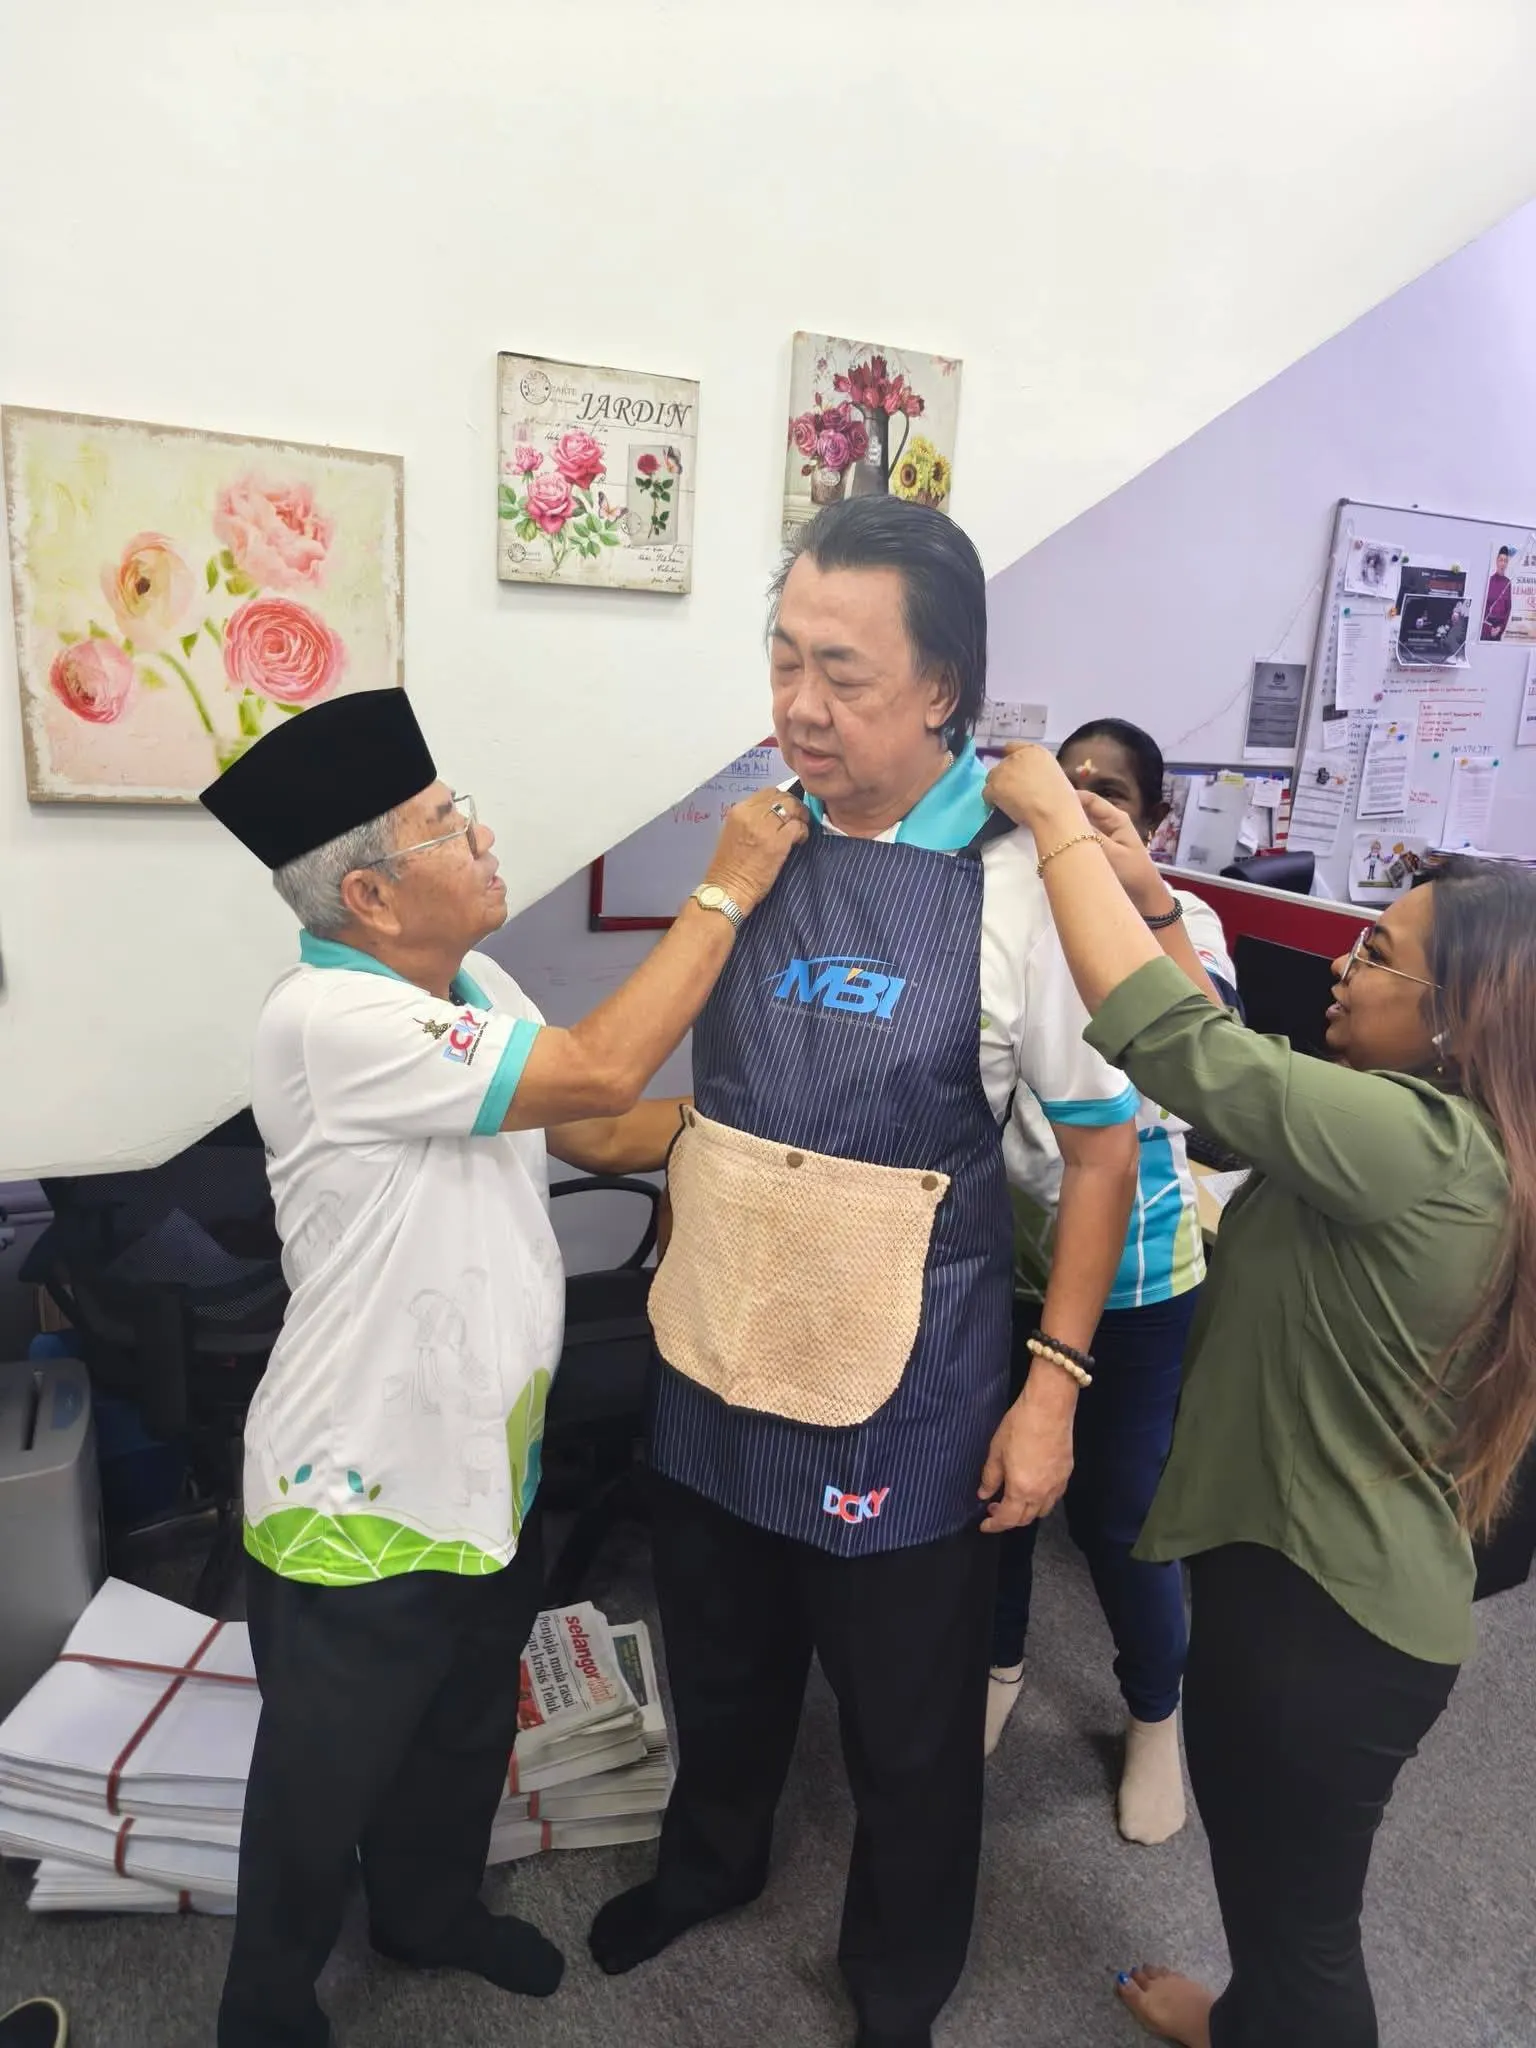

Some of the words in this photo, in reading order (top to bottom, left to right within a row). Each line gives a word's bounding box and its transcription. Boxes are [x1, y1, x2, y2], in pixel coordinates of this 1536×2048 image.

[576, 393, 692, 428] JARDIN
[775, 957, 907, 1019] MBI
[823, 1485, 890, 1523] DCKY
[531, 1652, 549, 1684] krisis
[541, 1684, 561, 1715] Teluk
[540, 1615, 560, 1655] Penjaja
[550, 1656, 568, 1683] mula
[559, 1684, 578, 1708] rasai
